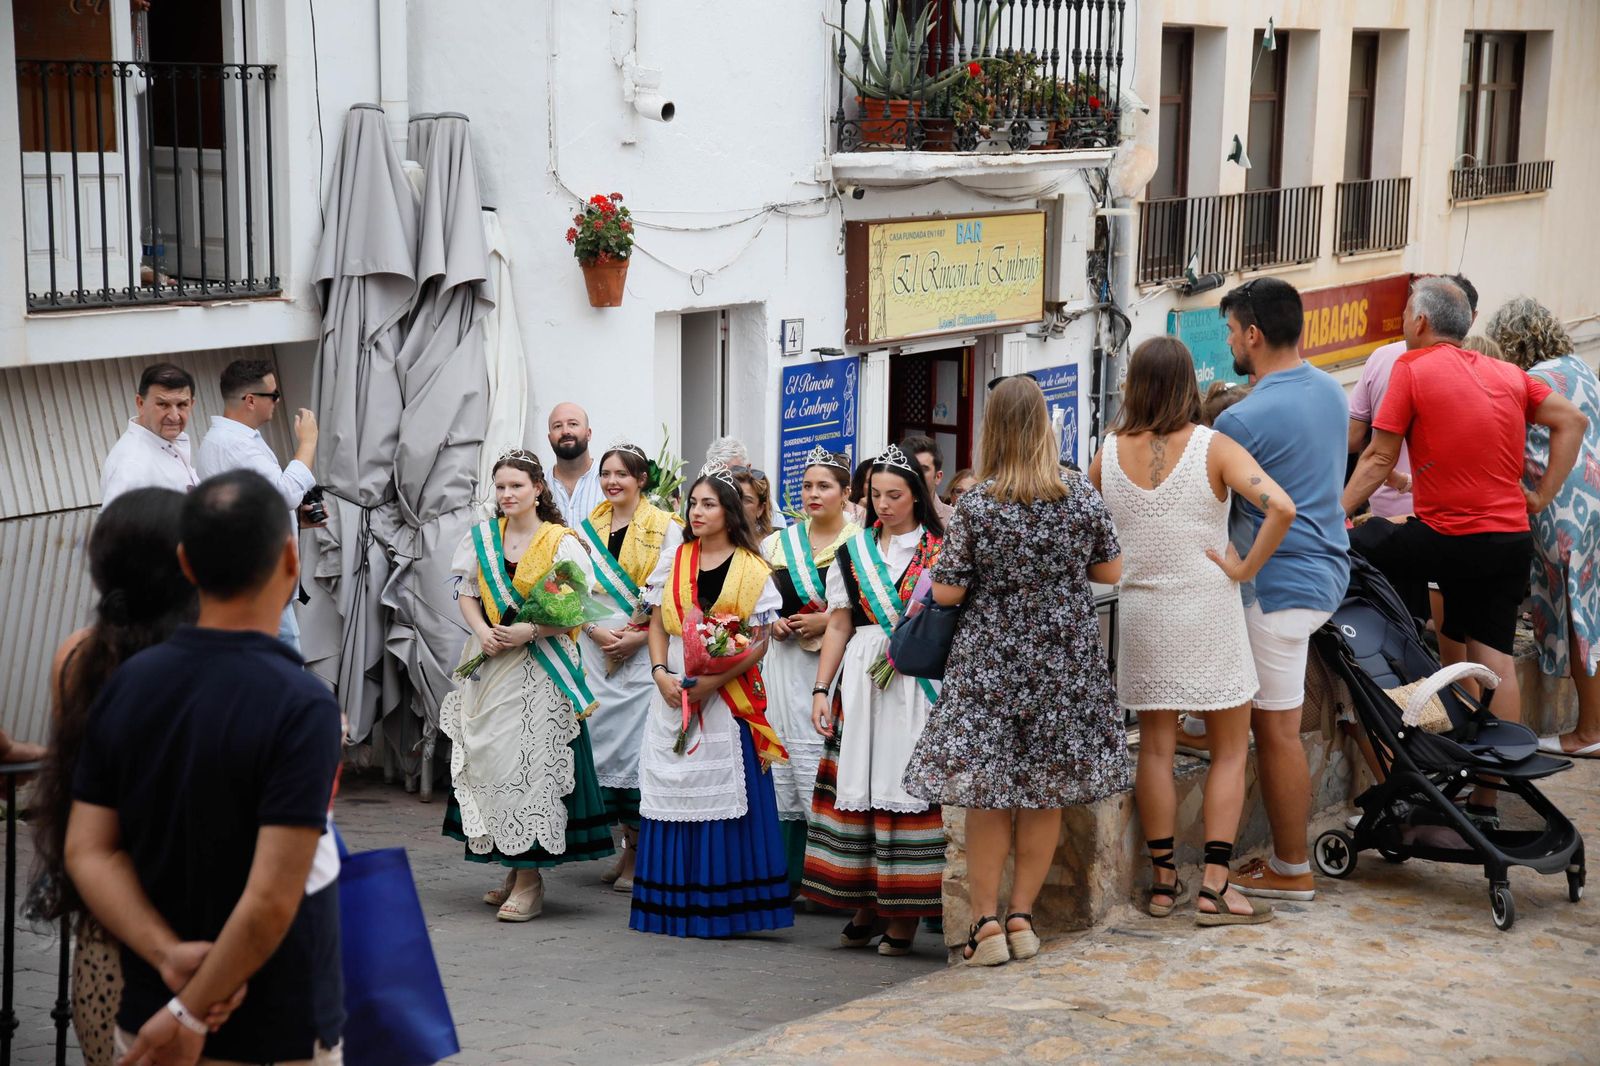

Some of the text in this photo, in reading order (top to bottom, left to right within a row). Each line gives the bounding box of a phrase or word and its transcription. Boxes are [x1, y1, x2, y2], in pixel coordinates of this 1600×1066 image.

[889, 233, 902, 241] CASA
[902, 231, 927, 240] FUNDADA
[927, 230, 934, 238] EN
[956, 220, 982, 245] BAR
[893, 253, 919, 295] El
[969, 248, 984, 287] de
[987, 244, 1041, 295] Embrujo
[1303, 299, 1368, 349] TABACOS
[789, 326, 797, 347] 4
[785, 373, 834, 395] El Rincón
[784, 396, 839, 420] de Embrujo
